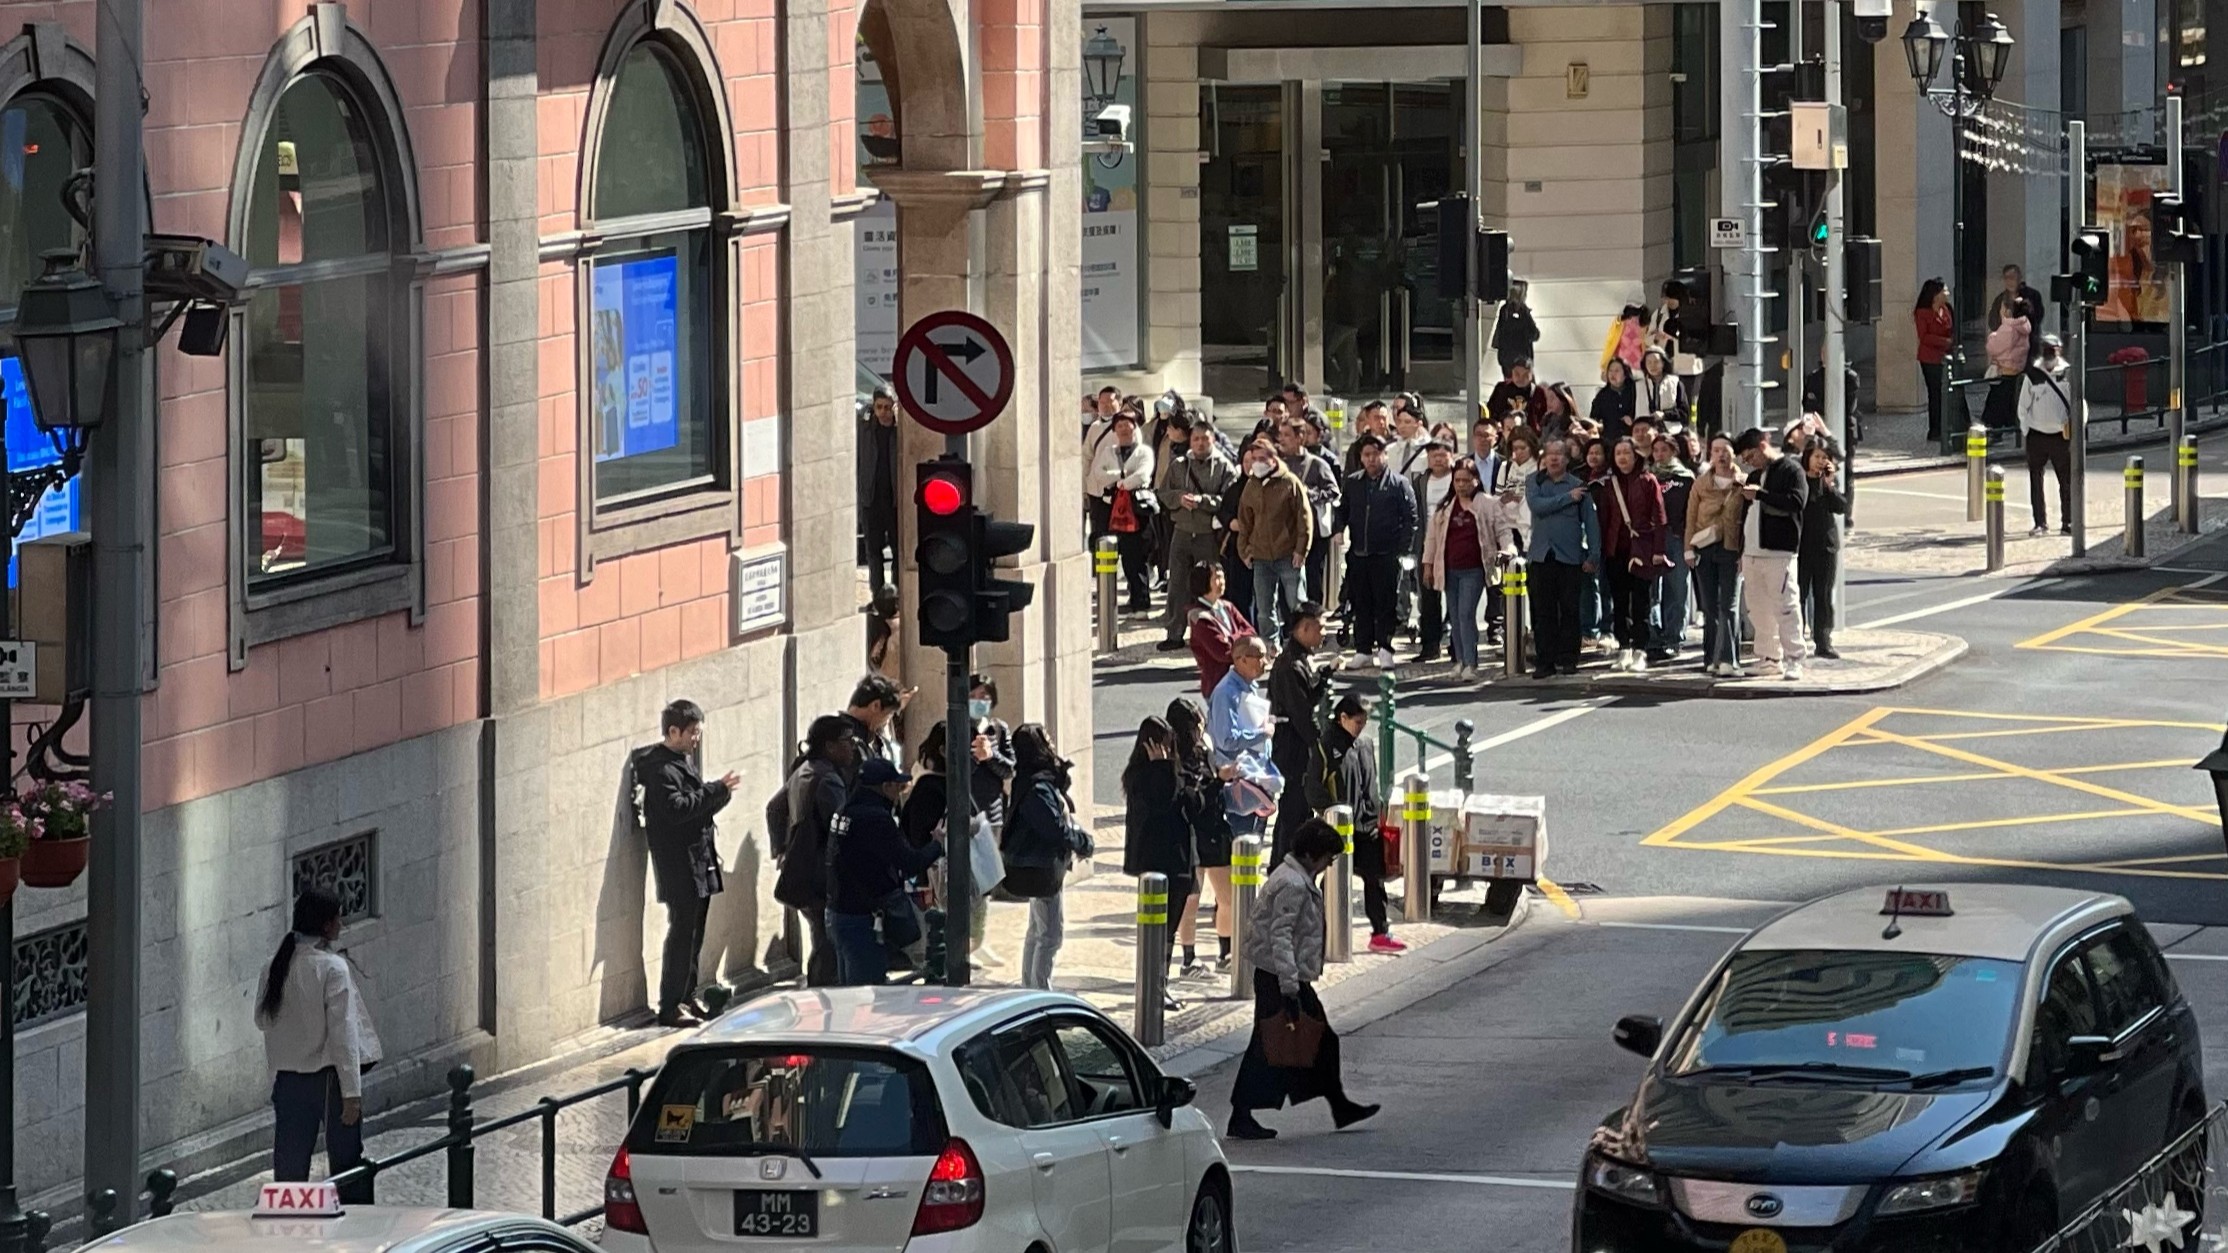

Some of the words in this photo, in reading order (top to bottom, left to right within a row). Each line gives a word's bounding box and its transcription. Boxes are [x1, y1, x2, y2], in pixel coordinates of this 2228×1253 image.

[1431, 825, 1443, 858] BOX
[1481, 855, 1515, 868] BX
[1889, 892, 1942, 909] TAXI
[263, 1188, 325, 1209] TAXI
[760, 1193, 792, 1213] MM
[741, 1214, 811, 1233] 43-23
